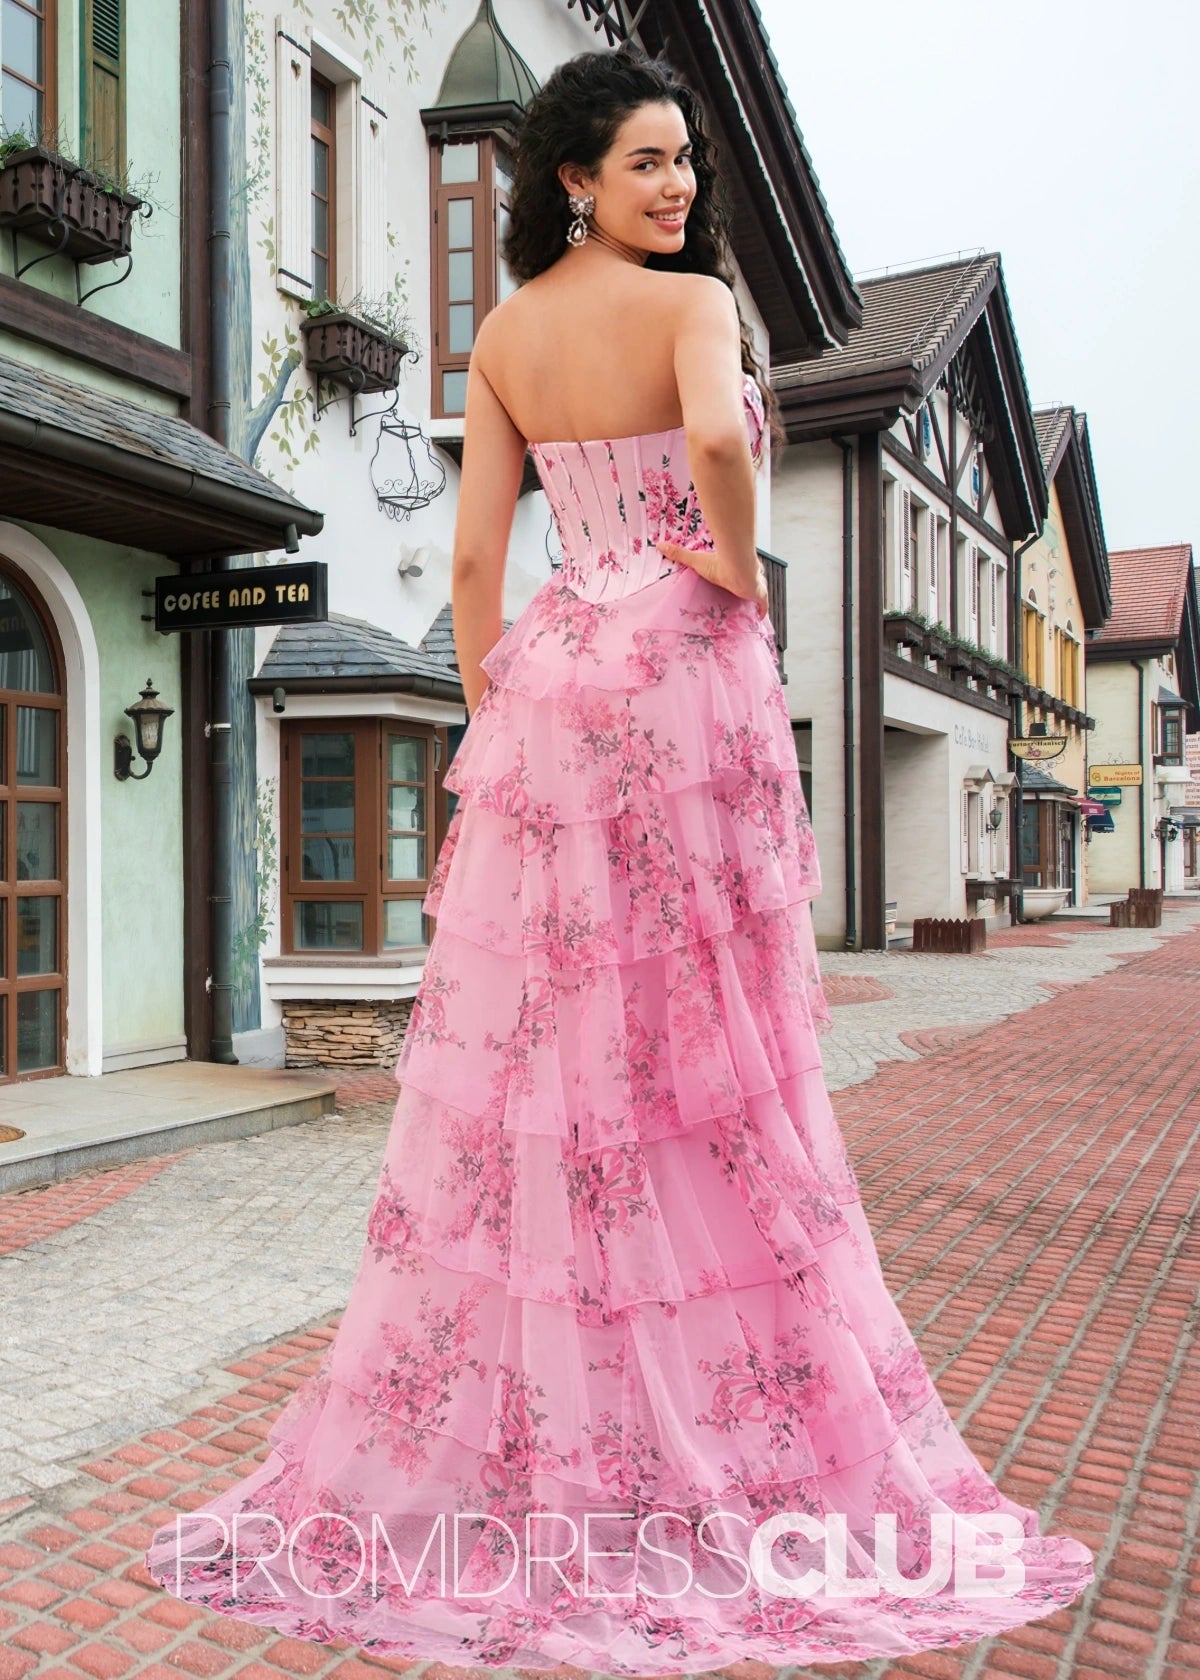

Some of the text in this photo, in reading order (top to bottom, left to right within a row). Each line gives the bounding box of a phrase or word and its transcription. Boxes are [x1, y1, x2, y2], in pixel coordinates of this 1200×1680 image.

[164, 583, 310, 612] COFEE AND TEA
